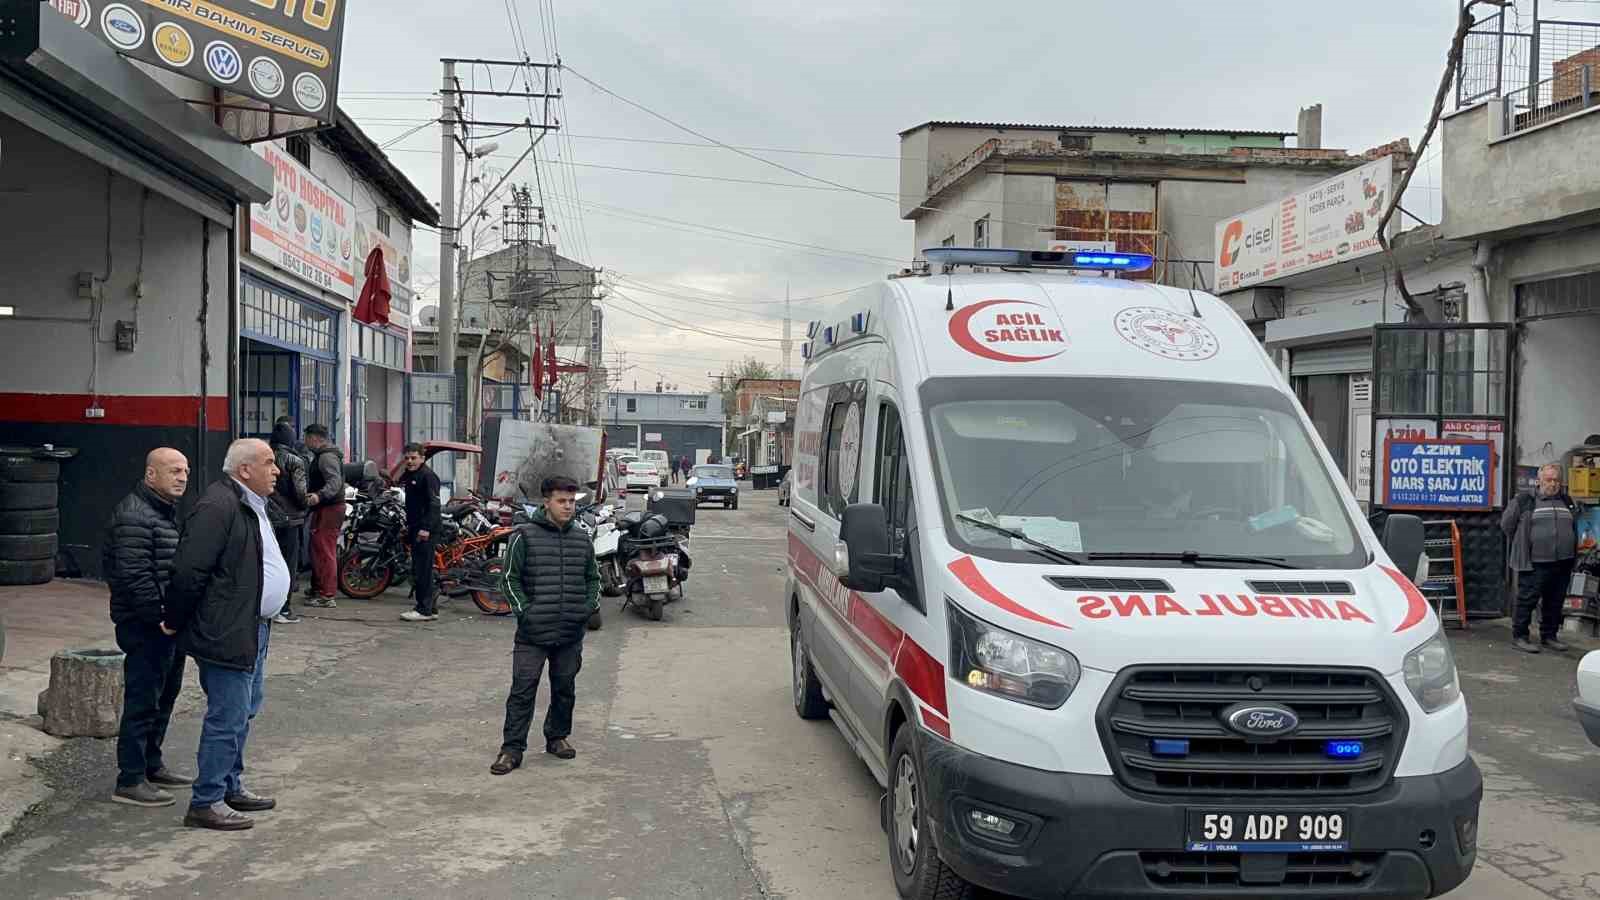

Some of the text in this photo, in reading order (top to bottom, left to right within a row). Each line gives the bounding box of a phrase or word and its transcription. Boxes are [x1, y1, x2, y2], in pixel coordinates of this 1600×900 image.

[195, 7, 257, 36] BAKIM
[264, 144, 297, 192] MOTO
[996, 311, 1044, 325] ACİL
[985, 327, 1064, 343] SAĞLIK
[1391, 458, 1418, 475] OTO
[1421, 456, 1485, 476] ELEKTRİK
[1392, 475, 1485, 493] MARŞ ŞARJ AKÜ
[1247, 713, 1284, 730] Ford
[1204, 814, 1343, 840] 59 ADP 909
